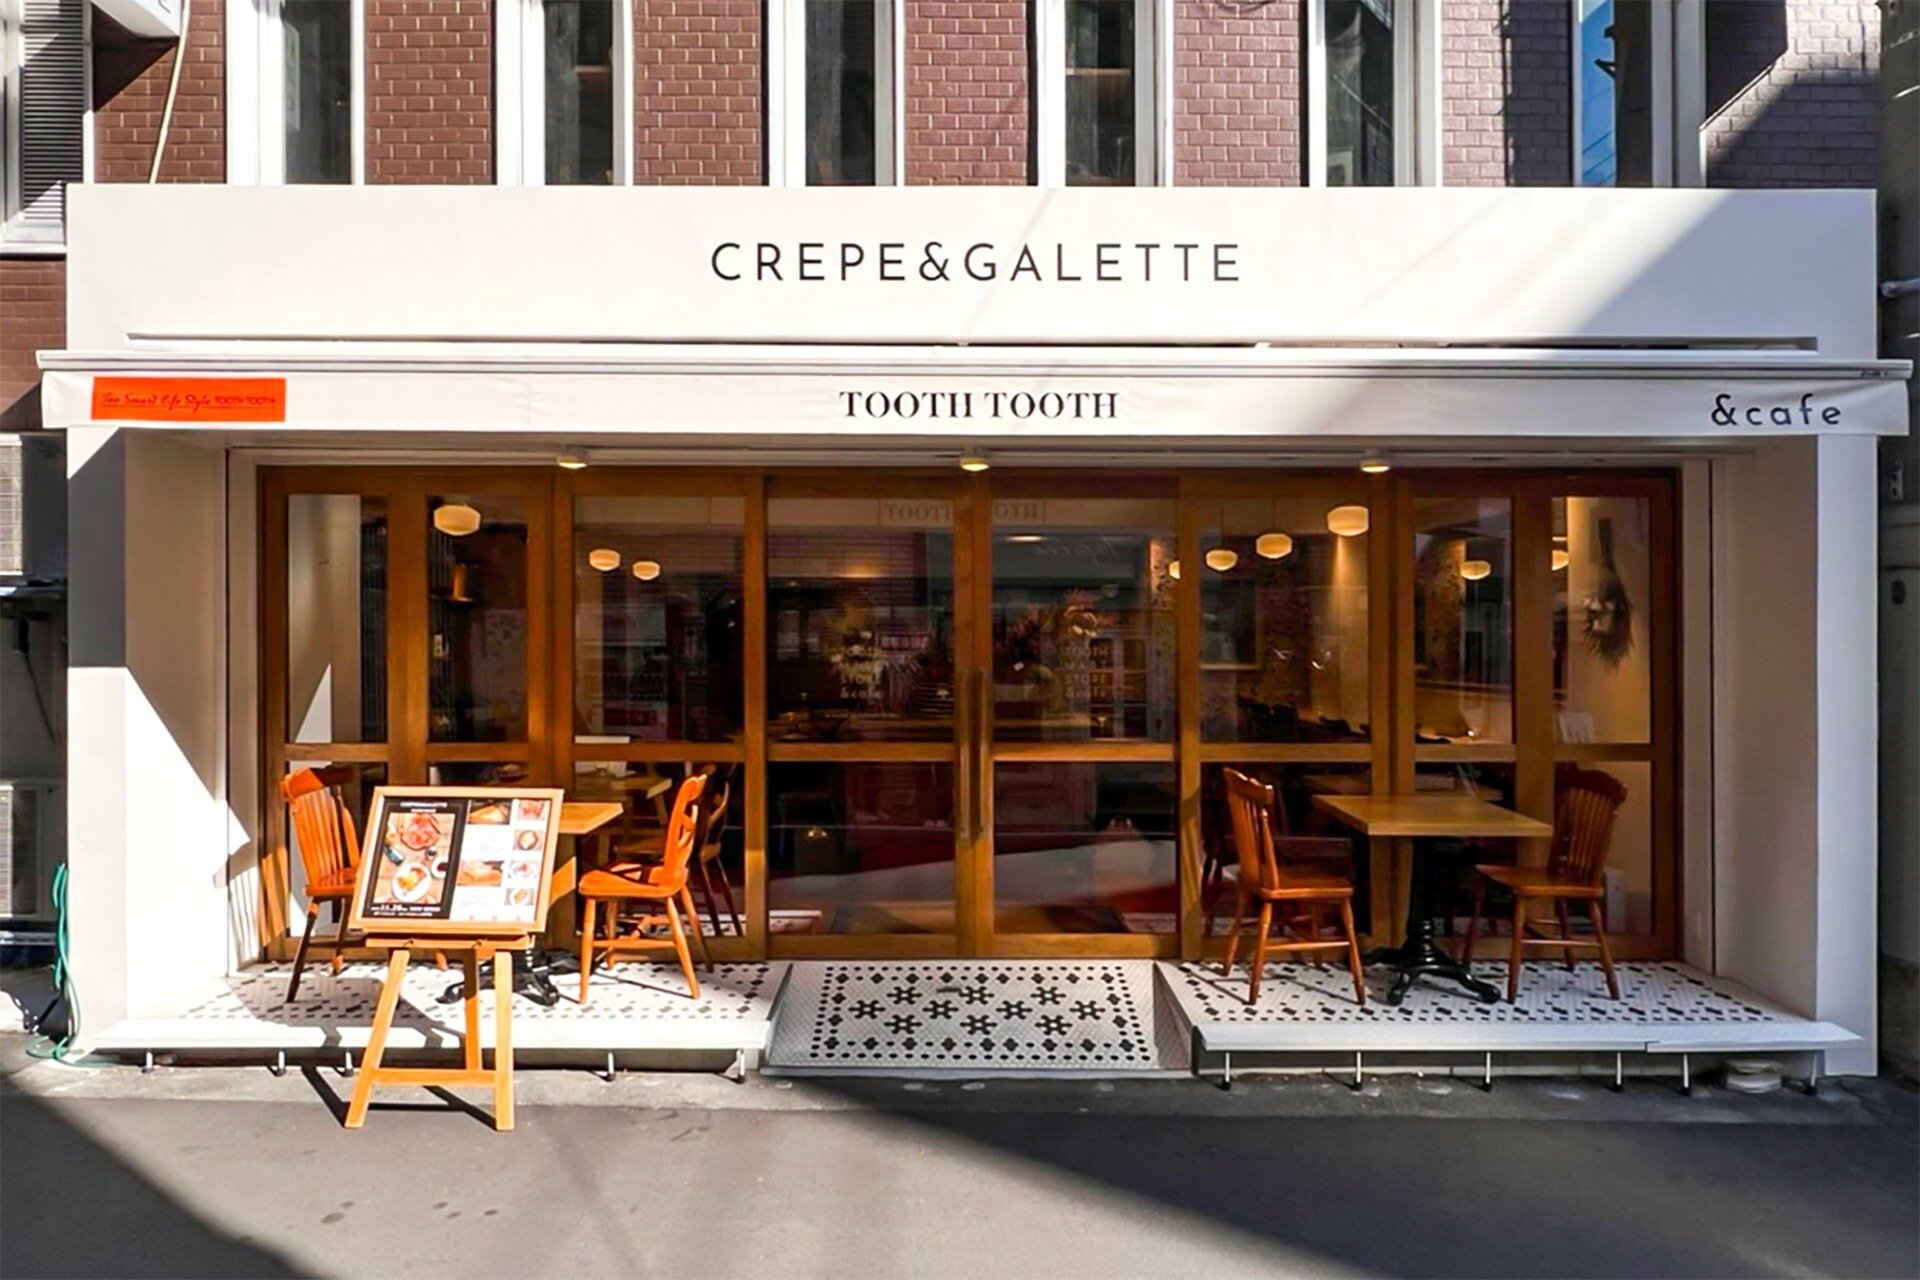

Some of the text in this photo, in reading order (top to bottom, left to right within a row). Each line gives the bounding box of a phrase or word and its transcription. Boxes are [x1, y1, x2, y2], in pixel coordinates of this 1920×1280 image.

[711, 242, 1241, 282] CREPE&GALETTE
[839, 391, 1120, 419] TOOTH TOOTH
[1711, 394, 1842, 426] &cafe
